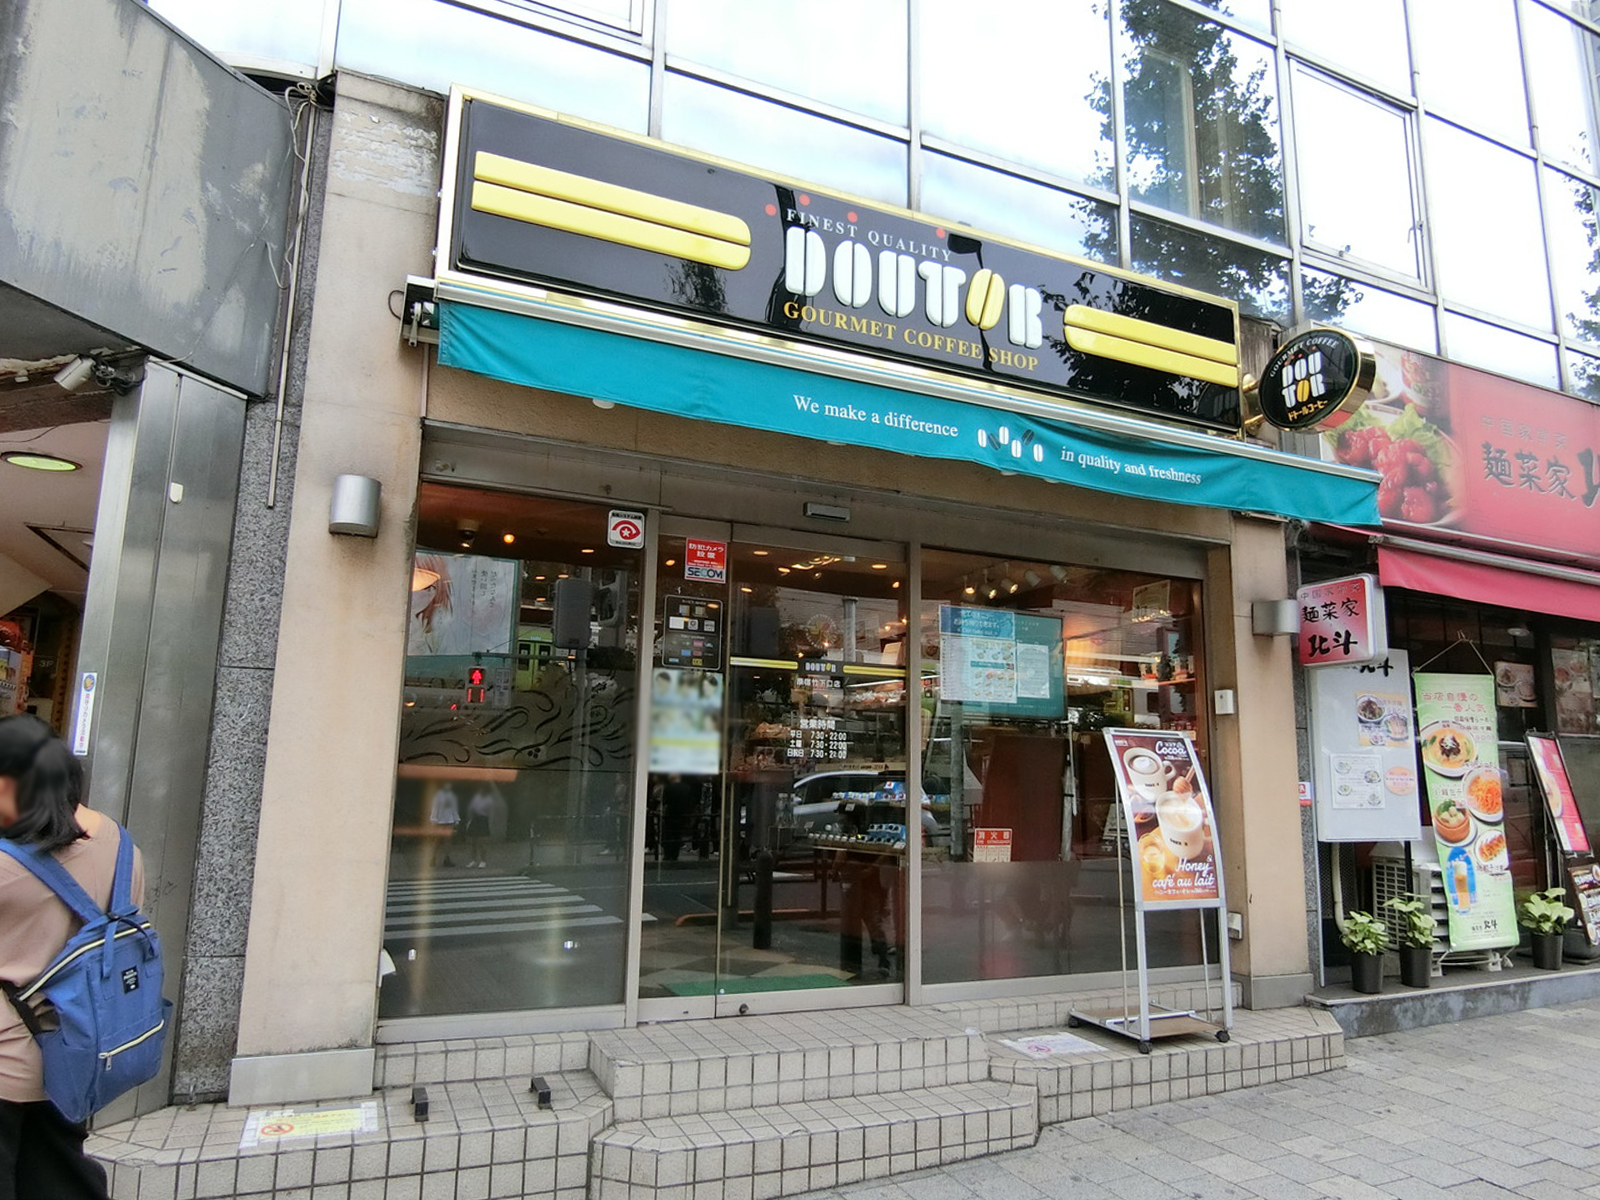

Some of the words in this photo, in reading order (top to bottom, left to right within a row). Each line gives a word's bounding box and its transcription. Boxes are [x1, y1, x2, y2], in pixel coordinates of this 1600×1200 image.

[786, 208, 857, 238] FINEST
[867, 229, 952, 262] QUALITY
[784, 225, 1043, 349] DOUTOR
[783, 301, 896, 341] GOURMET
[903, 327, 983, 360] COFFEE
[988, 346, 1039, 371] SHOP
[1269, 341, 1305, 378] GOURMET
[1306, 336, 1340, 349] COFFEE
[793, 394, 820, 414] We
[824, 404, 867, 422] make
[871, 412, 880, 424] a
[884, 411, 959, 437] difference
[1287, 400, 1329, 422] ドトールコーヒー
[1060, 446, 1074, 462] in
[1078, 451, 1121, 475] quality
[1124, 462, 1147, 477] and
[1149, 465, 1202, 485] freshness
[687, 566, 724, 580] SECOM
[1308, 629, 1359, 658] 北斗
[805, 662, 837, 673] DOUTOR
[800, 718, 836, 730] 営業時間
[1155, 740, 1188, 755] Cocoa
[1175, 857, 1213, 877] Honey
[1152, 873, 1176, 890] café
[1177, 877, 1193, 888] au
[1194, 872, 1215, 887] lait
